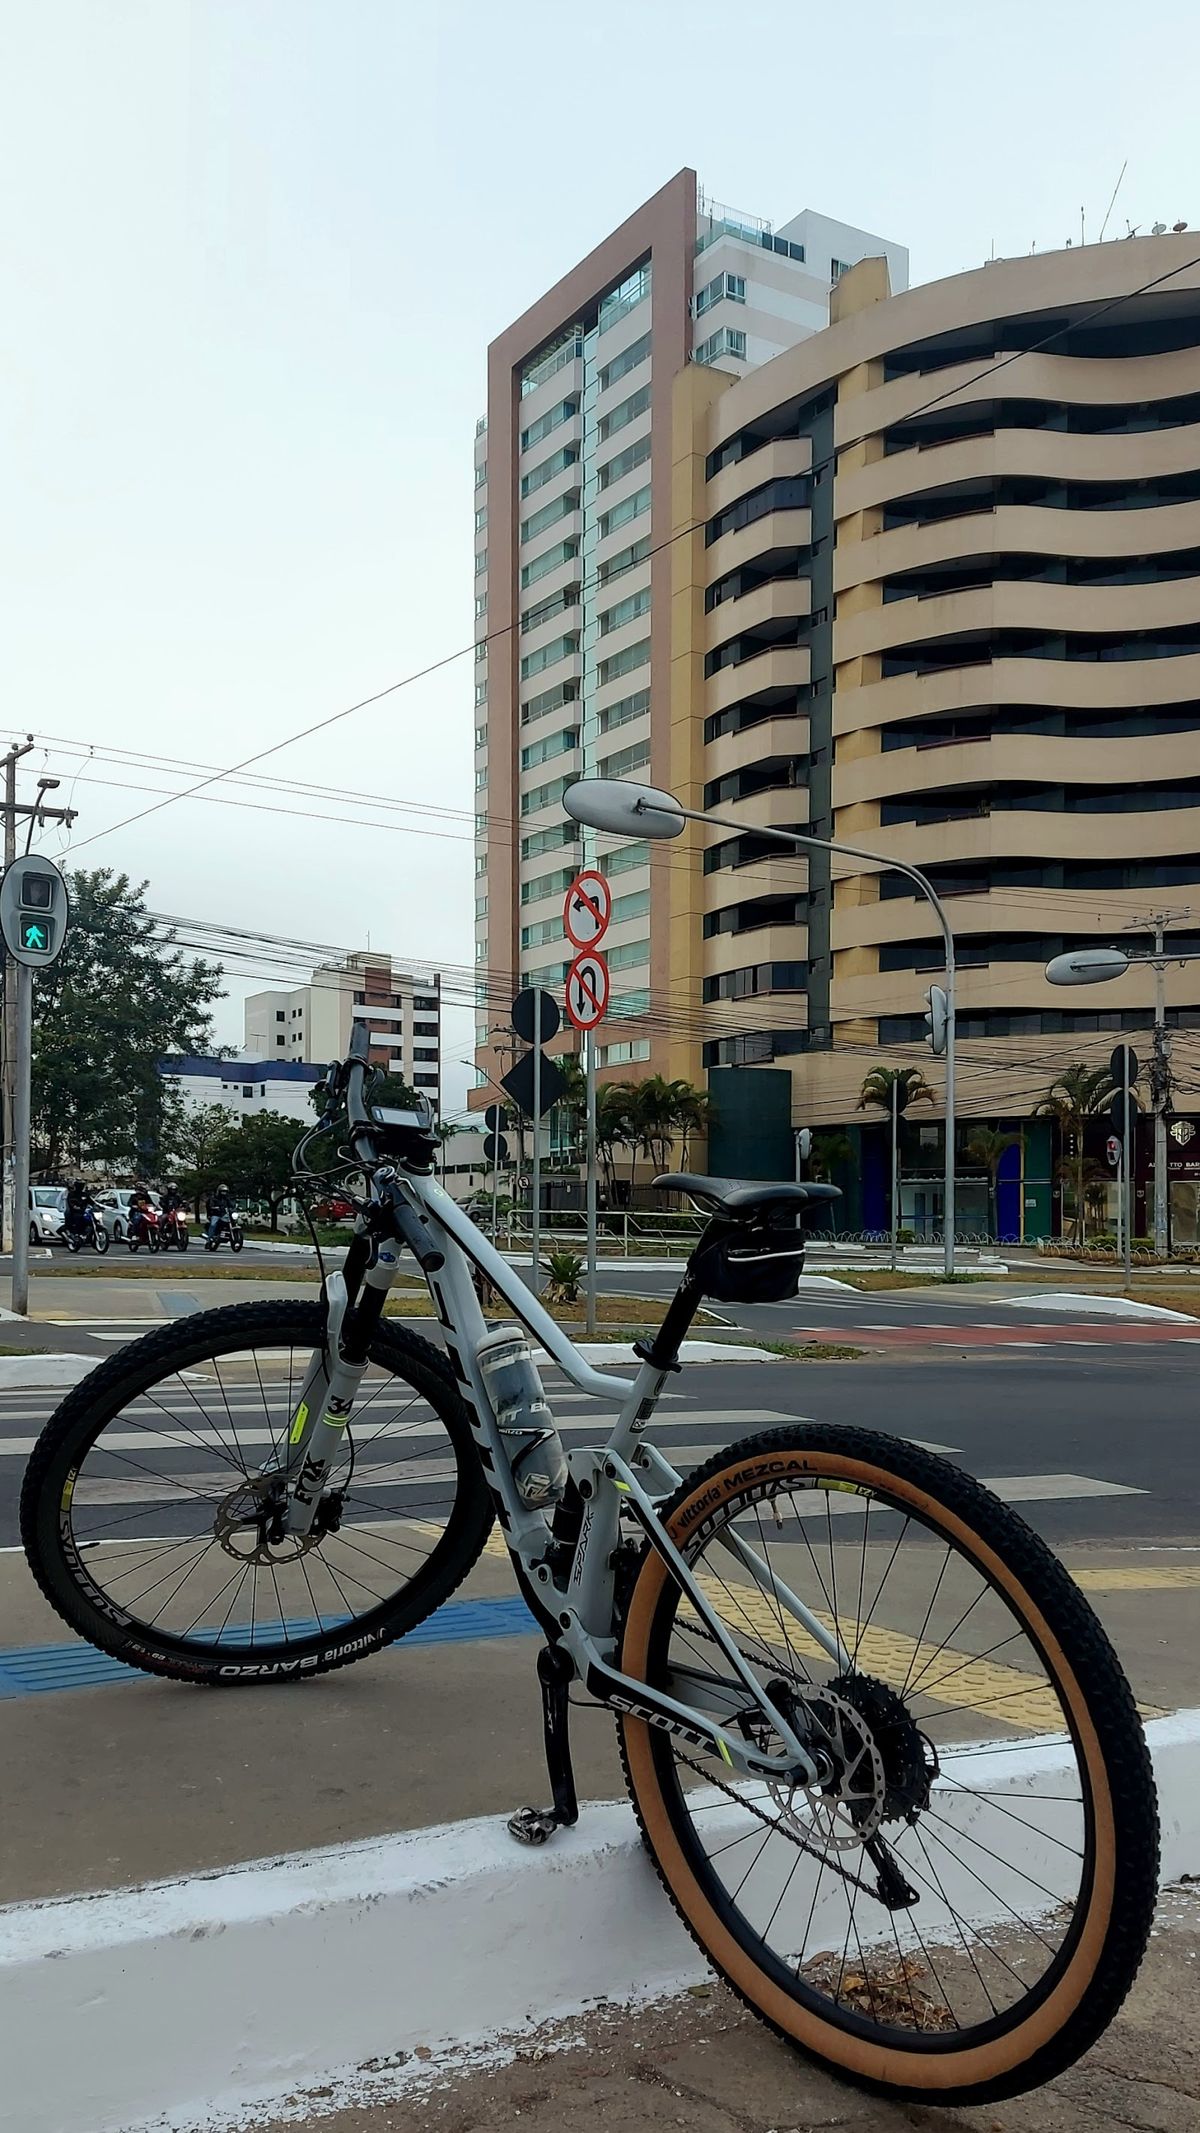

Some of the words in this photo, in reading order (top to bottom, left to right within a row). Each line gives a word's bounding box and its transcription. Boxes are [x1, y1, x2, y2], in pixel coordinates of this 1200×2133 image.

[677, 1485, 722, 1529] vittoria
[723, 1459, 818, 1490] MEZCAL
[219, 1655, 318, 1676] BARZO
[323, 1634, 376, 1662] vittoria
[605, 1693, 715, 1749] SCOTT
